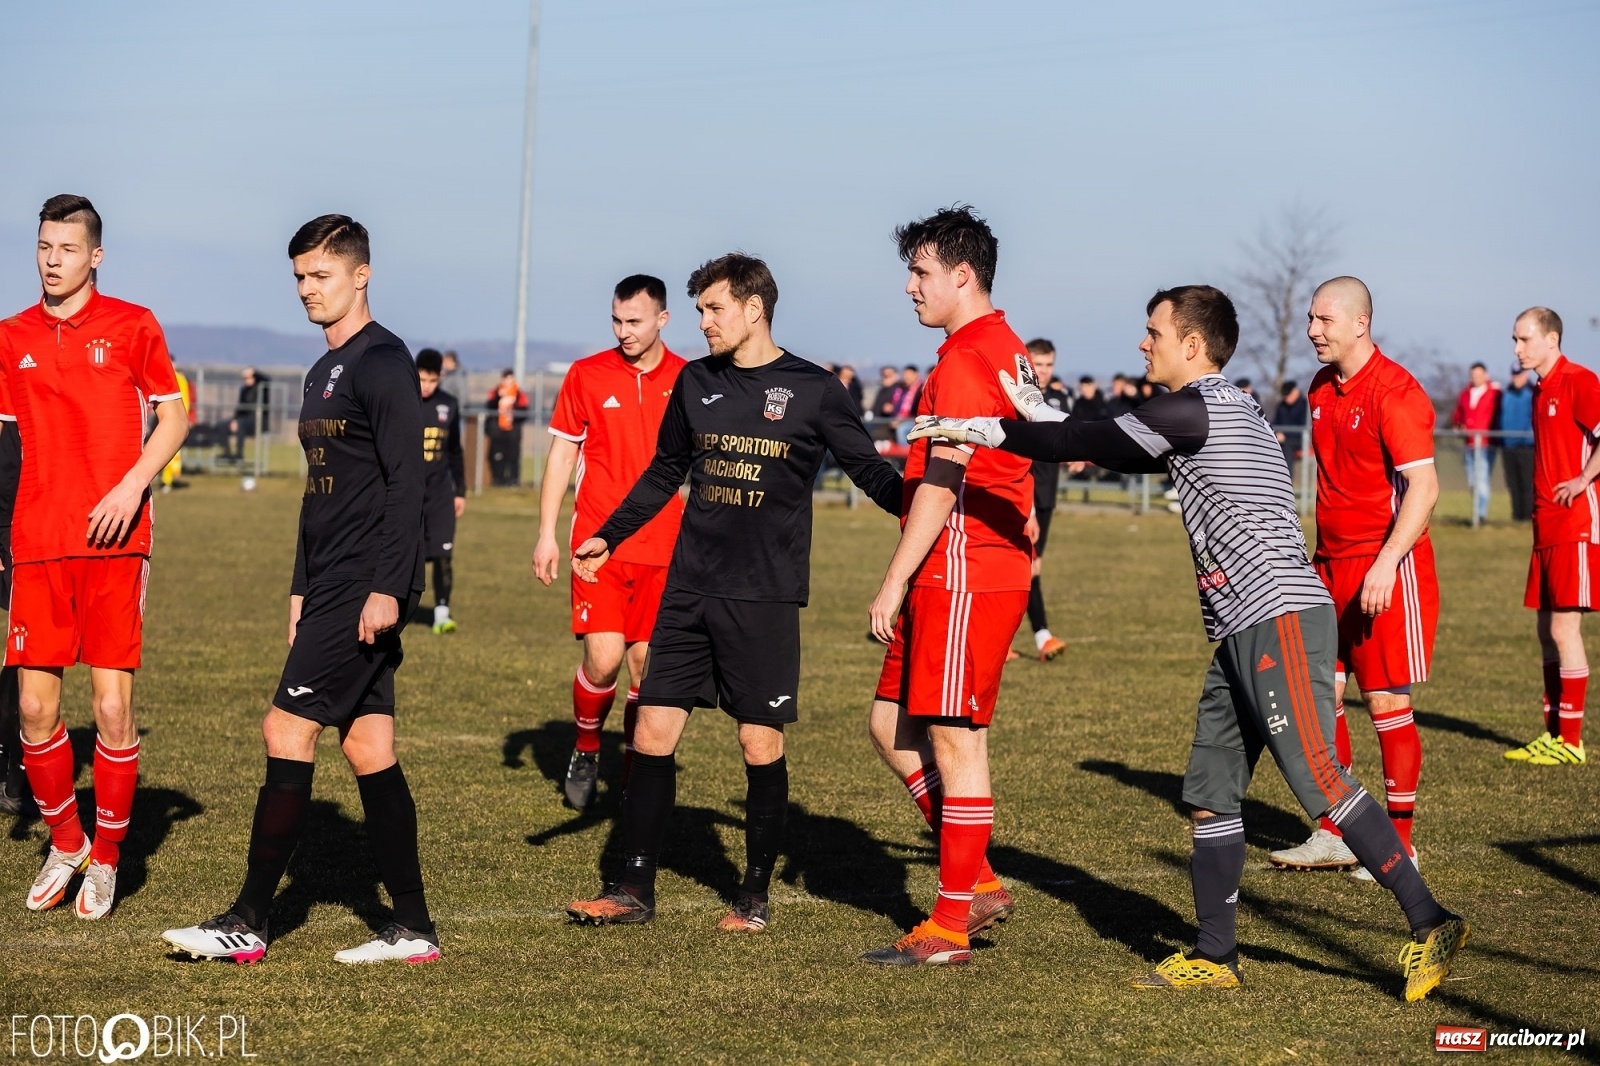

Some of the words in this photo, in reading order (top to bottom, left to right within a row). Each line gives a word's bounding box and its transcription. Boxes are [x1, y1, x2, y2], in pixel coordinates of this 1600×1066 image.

[767, 403, 783, 415] KS
[1352, 415, 1360, 429] 3
[720, 434, 791, 459] SPORTOWY
[703, 458, 762, 482] RACIBÓRZ
[319, 476, 334, 494] 17
[747, 490, 765, 508] 17
[580, 608, 588, 623] 4
